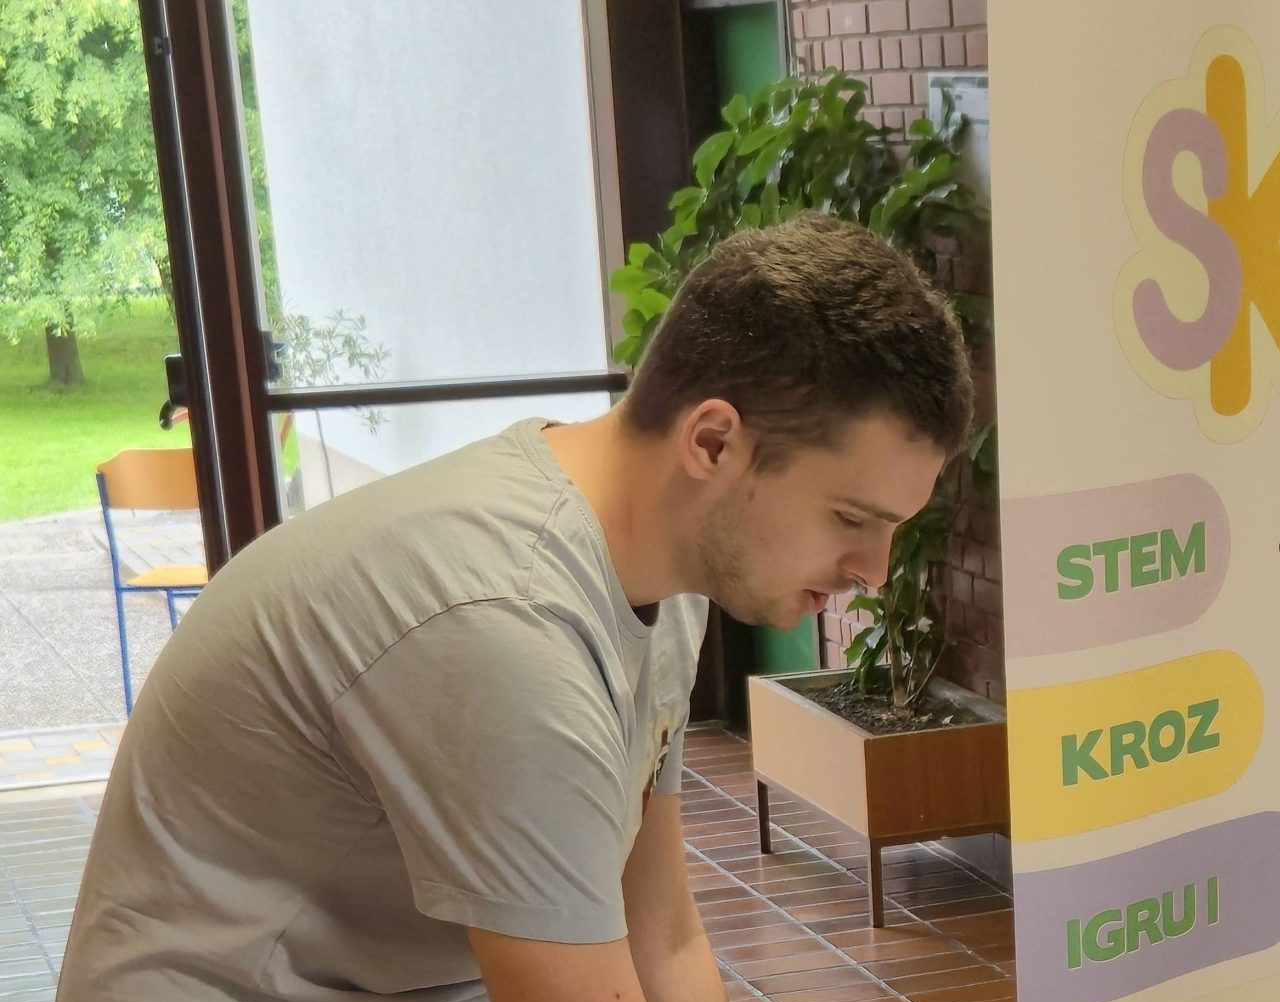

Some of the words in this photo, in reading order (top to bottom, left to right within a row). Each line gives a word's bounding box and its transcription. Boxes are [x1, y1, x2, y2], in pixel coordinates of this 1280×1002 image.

[1057, 521, 1206, 601] STEM
[1061, 699, 1221, 787] KROZ
[1066, 884, 1198, 969] IGRU
[1206, 875, 1220, 925] I
